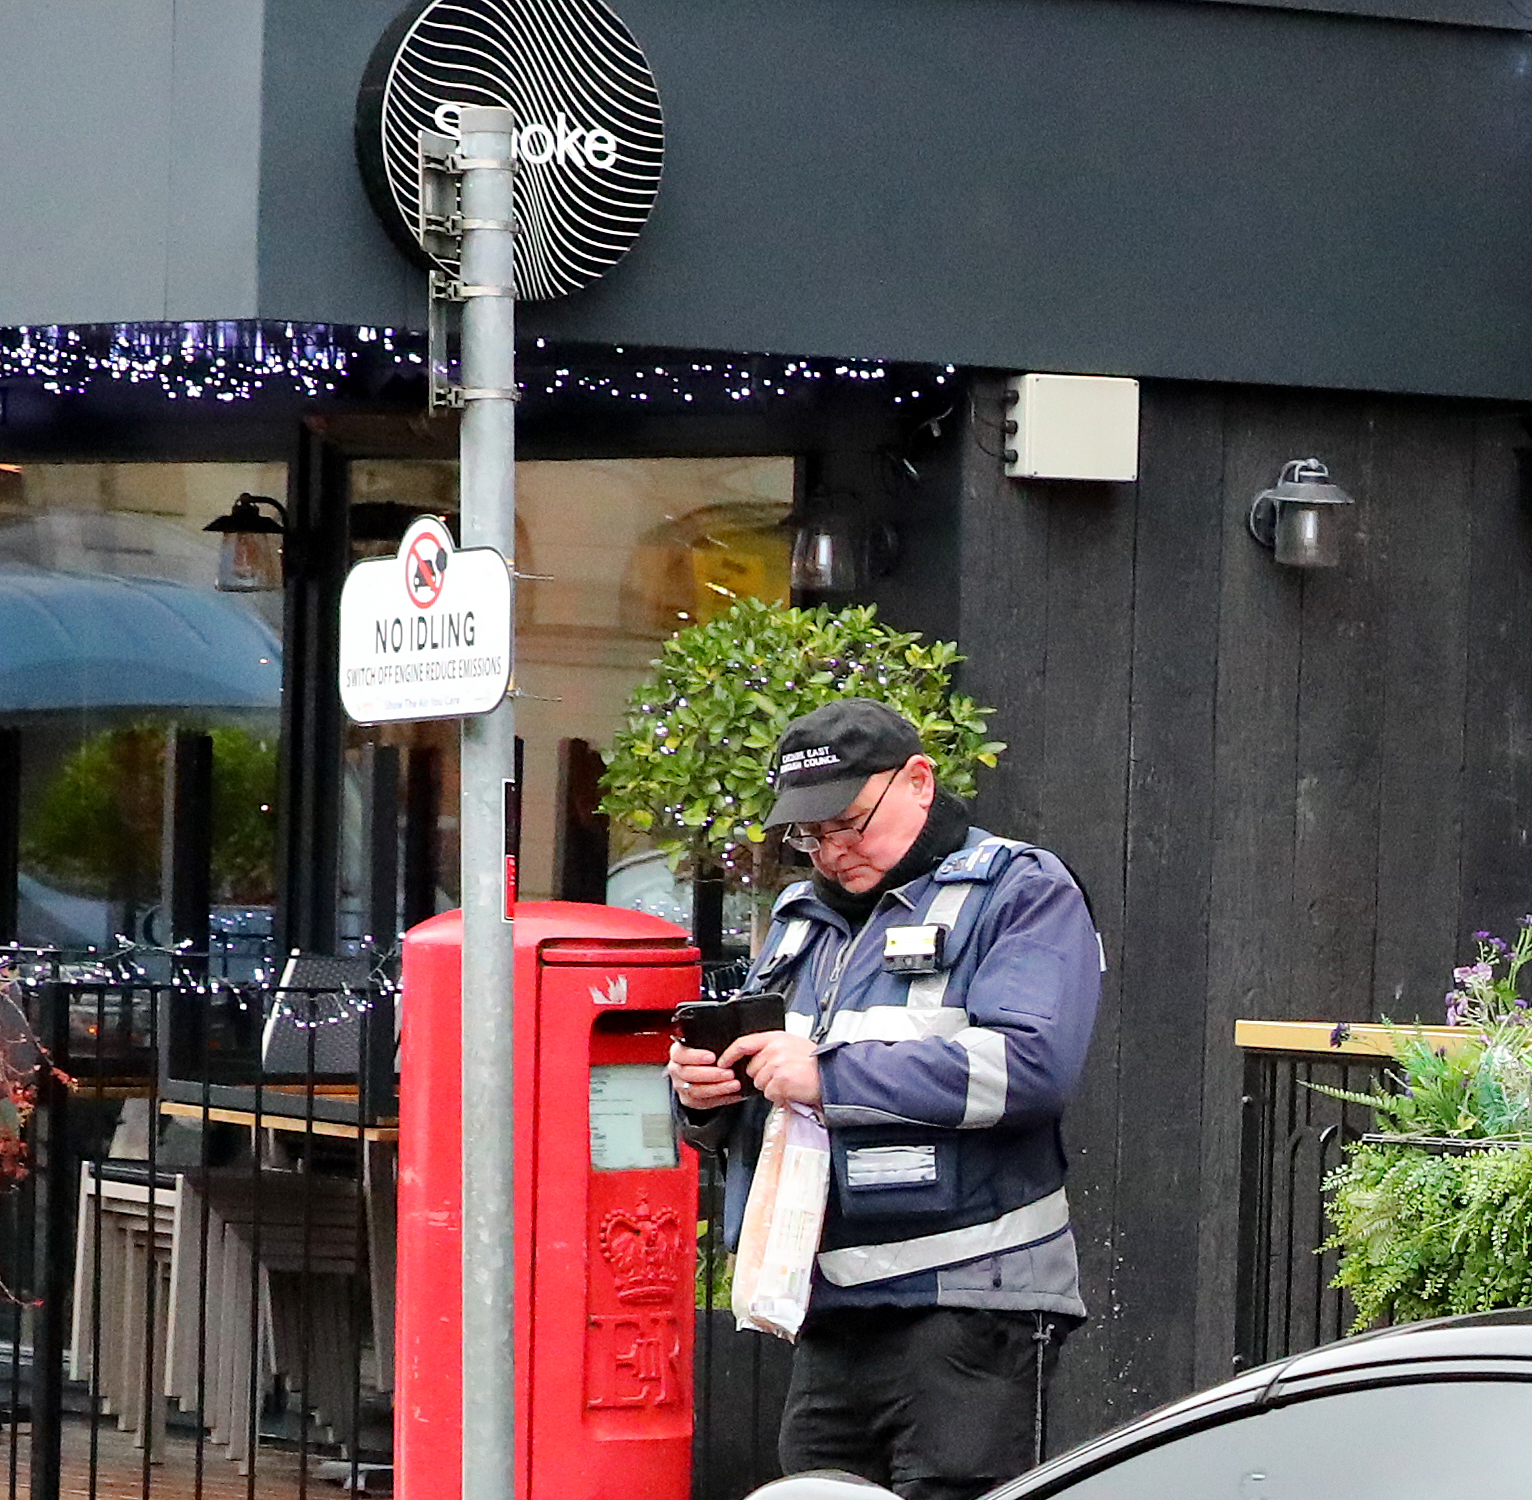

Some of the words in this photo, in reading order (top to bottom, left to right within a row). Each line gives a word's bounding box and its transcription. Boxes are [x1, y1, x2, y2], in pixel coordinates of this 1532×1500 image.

[375, 617, 403, 654] NO
[410, 611, 475, 651] IDLING
[346, 667, 376, 688] SWITCH
[378, 666, 393, 685] OFF
[395, 663, 423, 684] ENGINE
[425, 660, 456, 681] REDUCE
[458, 656, 502, 679] EMISSIONS
